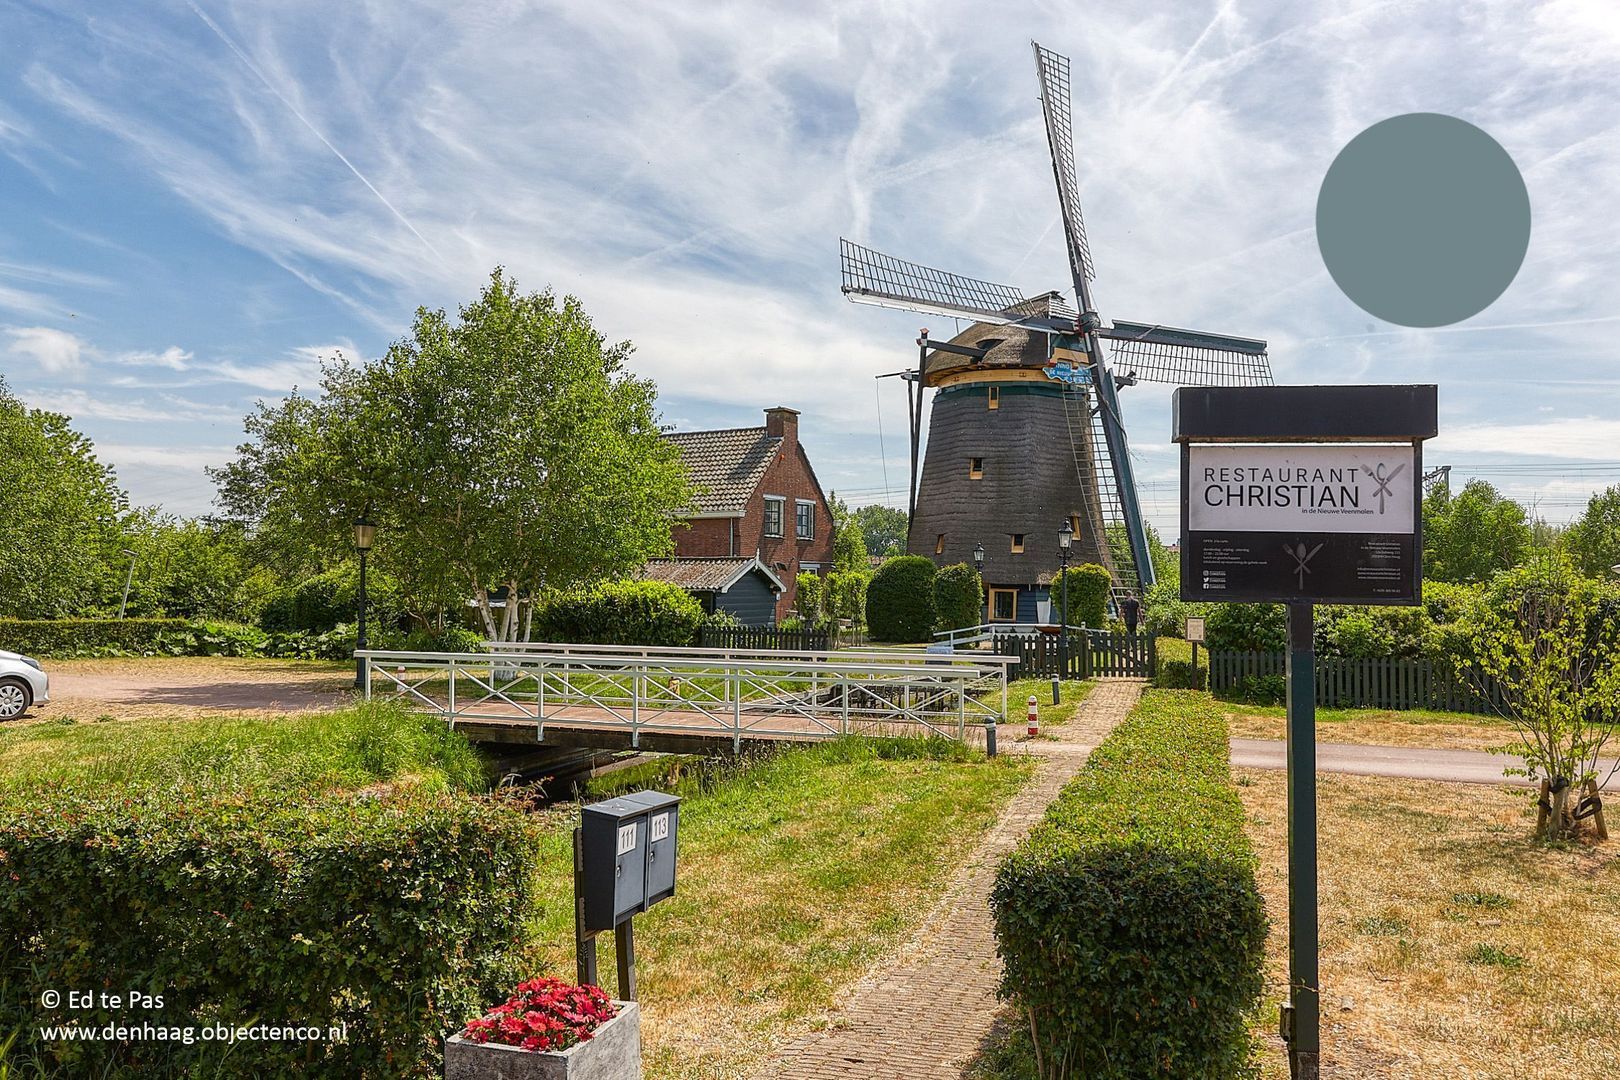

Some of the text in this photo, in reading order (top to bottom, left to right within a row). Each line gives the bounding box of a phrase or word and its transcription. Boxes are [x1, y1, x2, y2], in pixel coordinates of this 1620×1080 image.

[1204, 467, 1359, 483] RESTAURANT
[1204, 484, 1359, 508] CHRISTIAN
[654, 817, 667, 837] 113
[621, 828, 634, 849] 111
